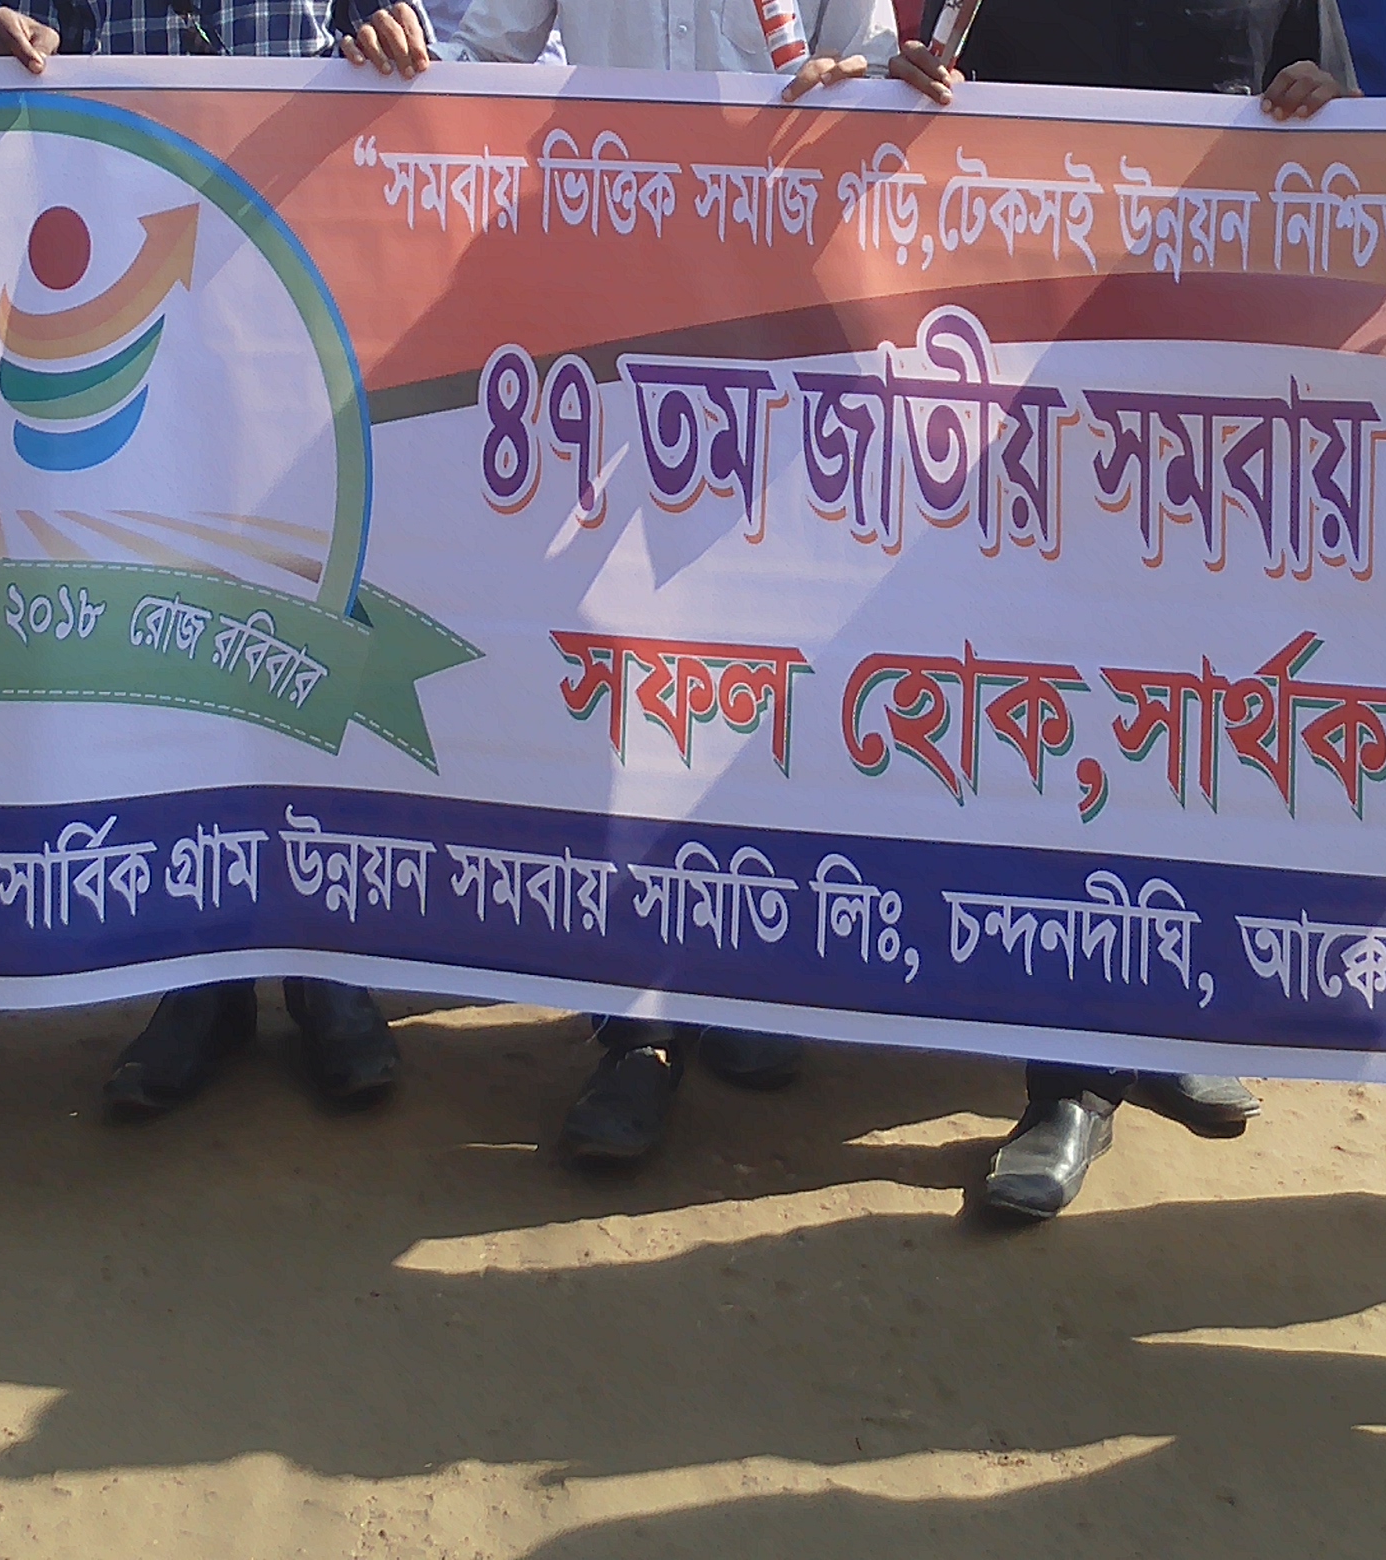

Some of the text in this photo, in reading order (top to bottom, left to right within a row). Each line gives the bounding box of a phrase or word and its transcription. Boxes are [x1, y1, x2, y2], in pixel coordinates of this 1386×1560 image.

[538, 128, 682, 237] ভিত্তিক
[690, 155, 824, 247] সমাজ
[1114, 155, 1260, 284] উন্নয়ন
[484, 344, 600, 525] ৪৭
[626, 364, 775, 540] তম
[794, 312, 1071, 555] জাতীয়
[4, 585, 105, 641] ২০১৮
[129, 595, 209, 654] রোজ
[212, 607, 329, 708] রবিবার
[548, 627, 813, 775] সফল
[163, 826, 270, 912] গ্রাম
[280, 806, 435, 922] উন্নয়ন
[445, 844, 616, 938] সমবায়
[628, 841, 798, 950] সমিতি
